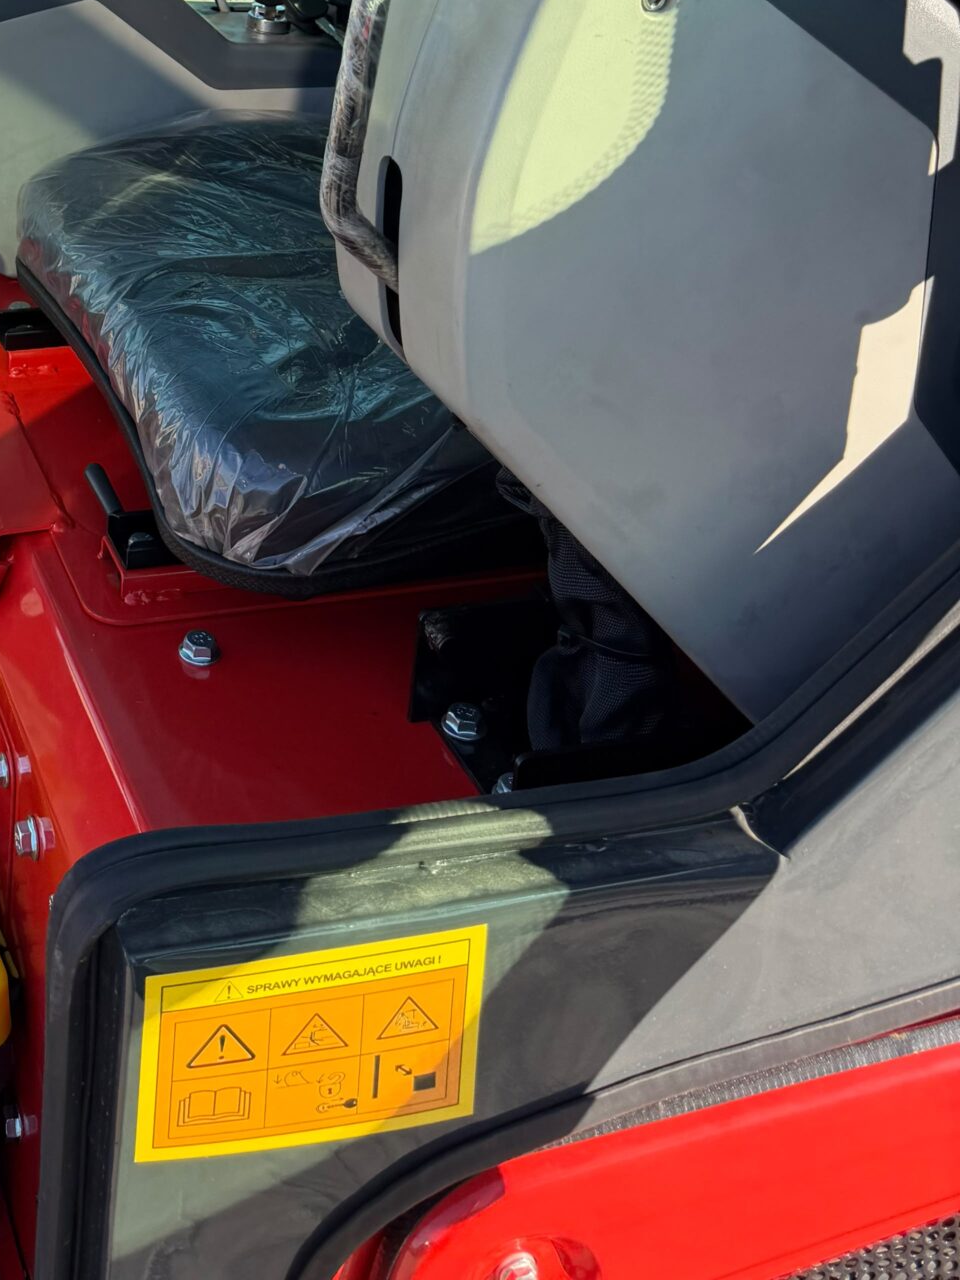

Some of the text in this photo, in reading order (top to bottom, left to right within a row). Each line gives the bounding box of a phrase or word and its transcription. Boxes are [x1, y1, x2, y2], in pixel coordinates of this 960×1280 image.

[246, 978, 301, 995] SPRAWY
[303, 963, 393, 987] WYMAGAJĄCE
[394, 956, 436, 971] UWAGI
